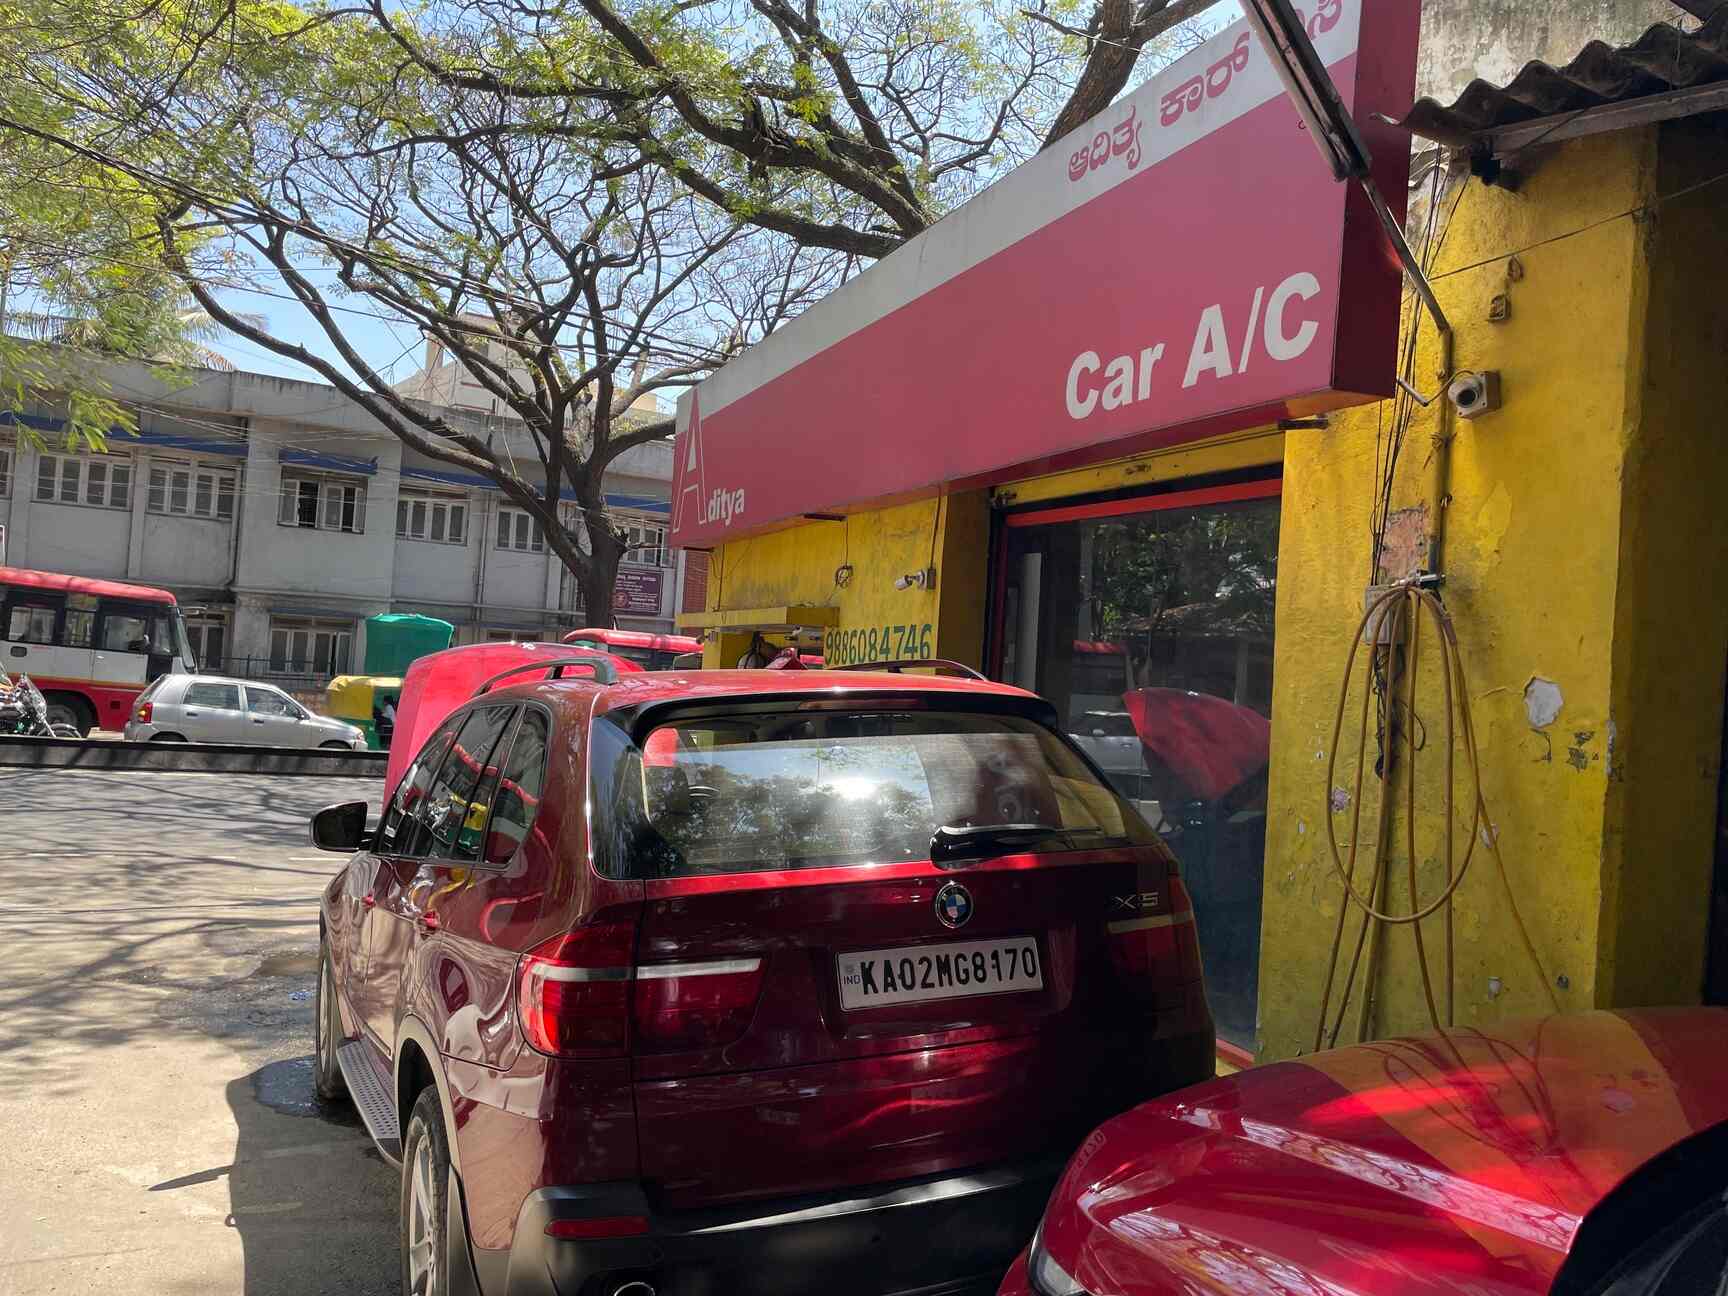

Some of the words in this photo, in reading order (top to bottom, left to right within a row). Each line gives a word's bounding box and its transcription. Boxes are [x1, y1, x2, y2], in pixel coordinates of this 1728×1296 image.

[1068, 104, 1142, 181] ಆದಿತ್ಯ
[1161, 31, 1250, 127] ಕಾರ್
[1066, 343, 1166, 419] Car
[1182, 271, 1321, 388] A/C
[672, 388, 745, 534] Aditya
[825, 623, 932, 665] 9886084746
[1114, 891, 1159, 909] X5
[860, 947, 1037, 995] KA02MG8170
